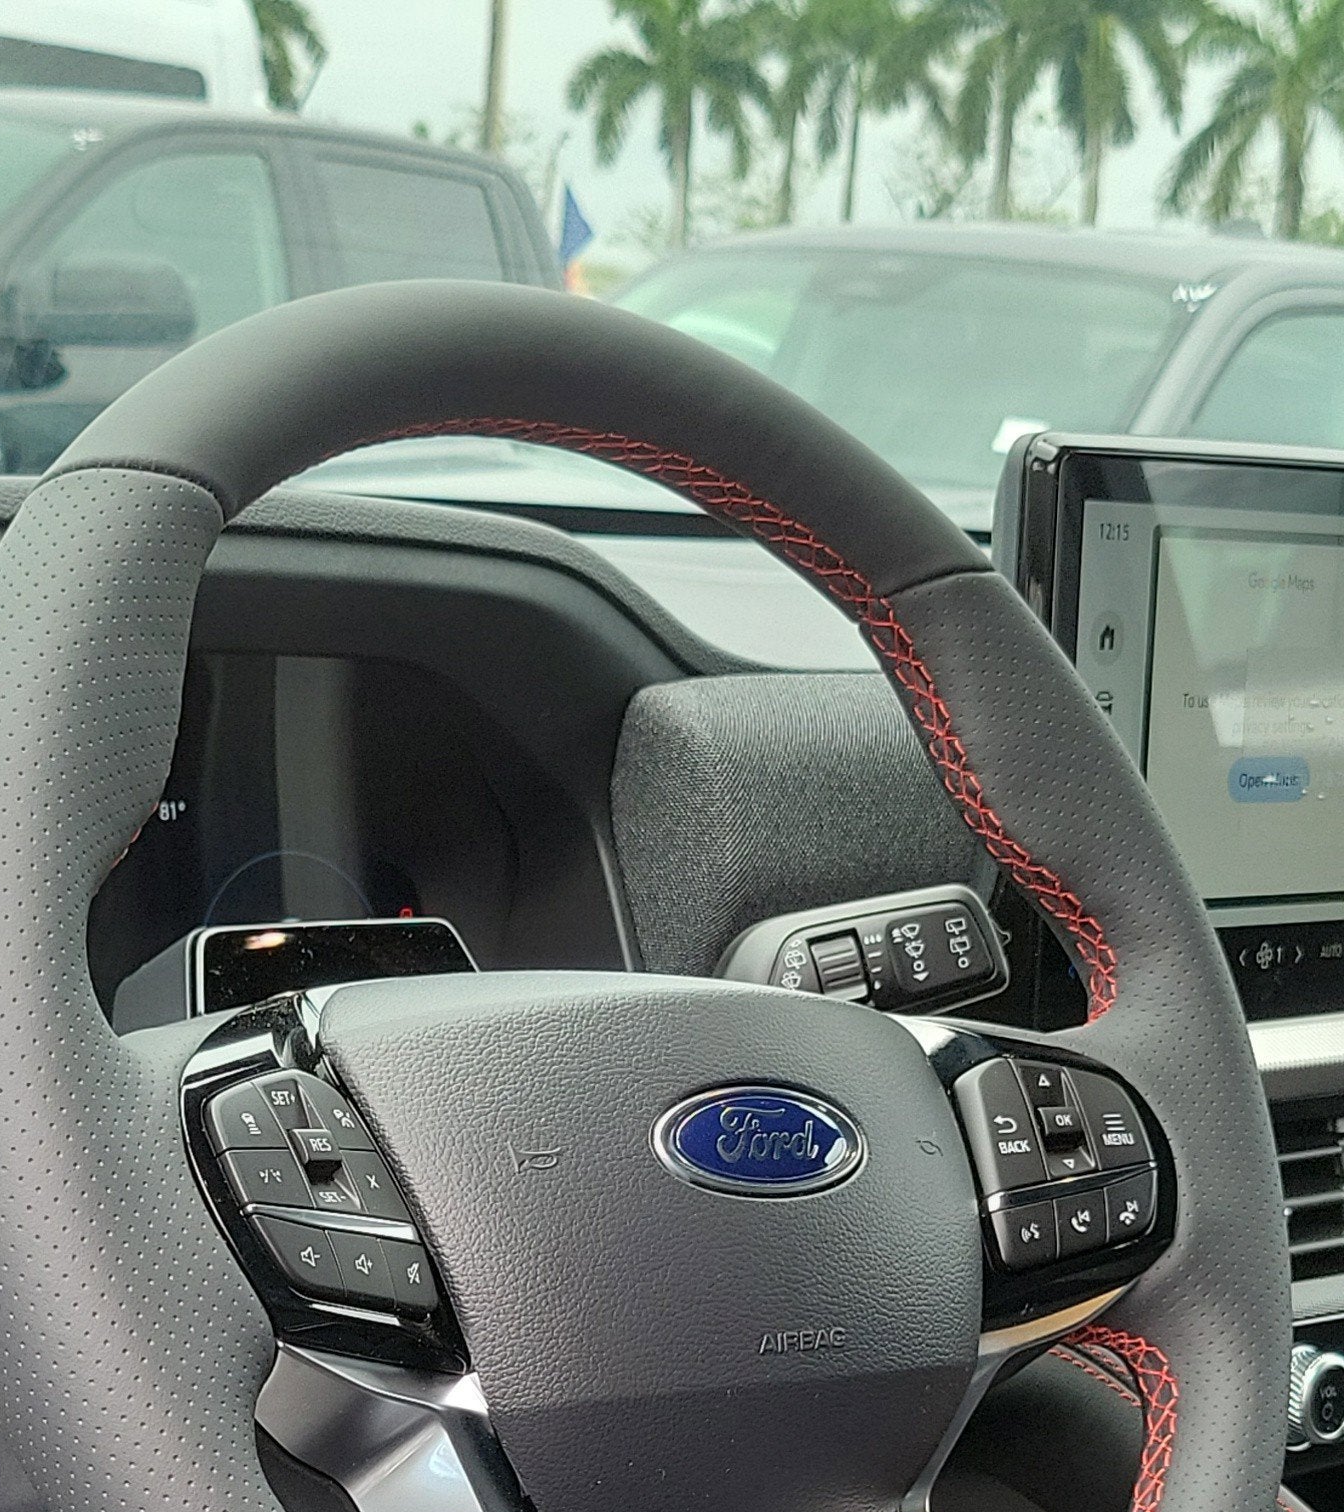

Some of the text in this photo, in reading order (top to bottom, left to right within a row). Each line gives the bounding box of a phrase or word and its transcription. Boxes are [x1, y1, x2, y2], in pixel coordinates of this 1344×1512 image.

[1099, 522, 1130, 542] 12:15
[1182, 693, 1194, 708] To
[1054, 1114, 1074, 1127] OK
[716, 1106, 820, 1163] Ford
[1102, 1132, 1136, 1146] MENU
[309, 1137, 332, 1152] RES
[998, 1139, 1032, 1154] BACK
[759, 1327, 847, 1354] AIRBAG
